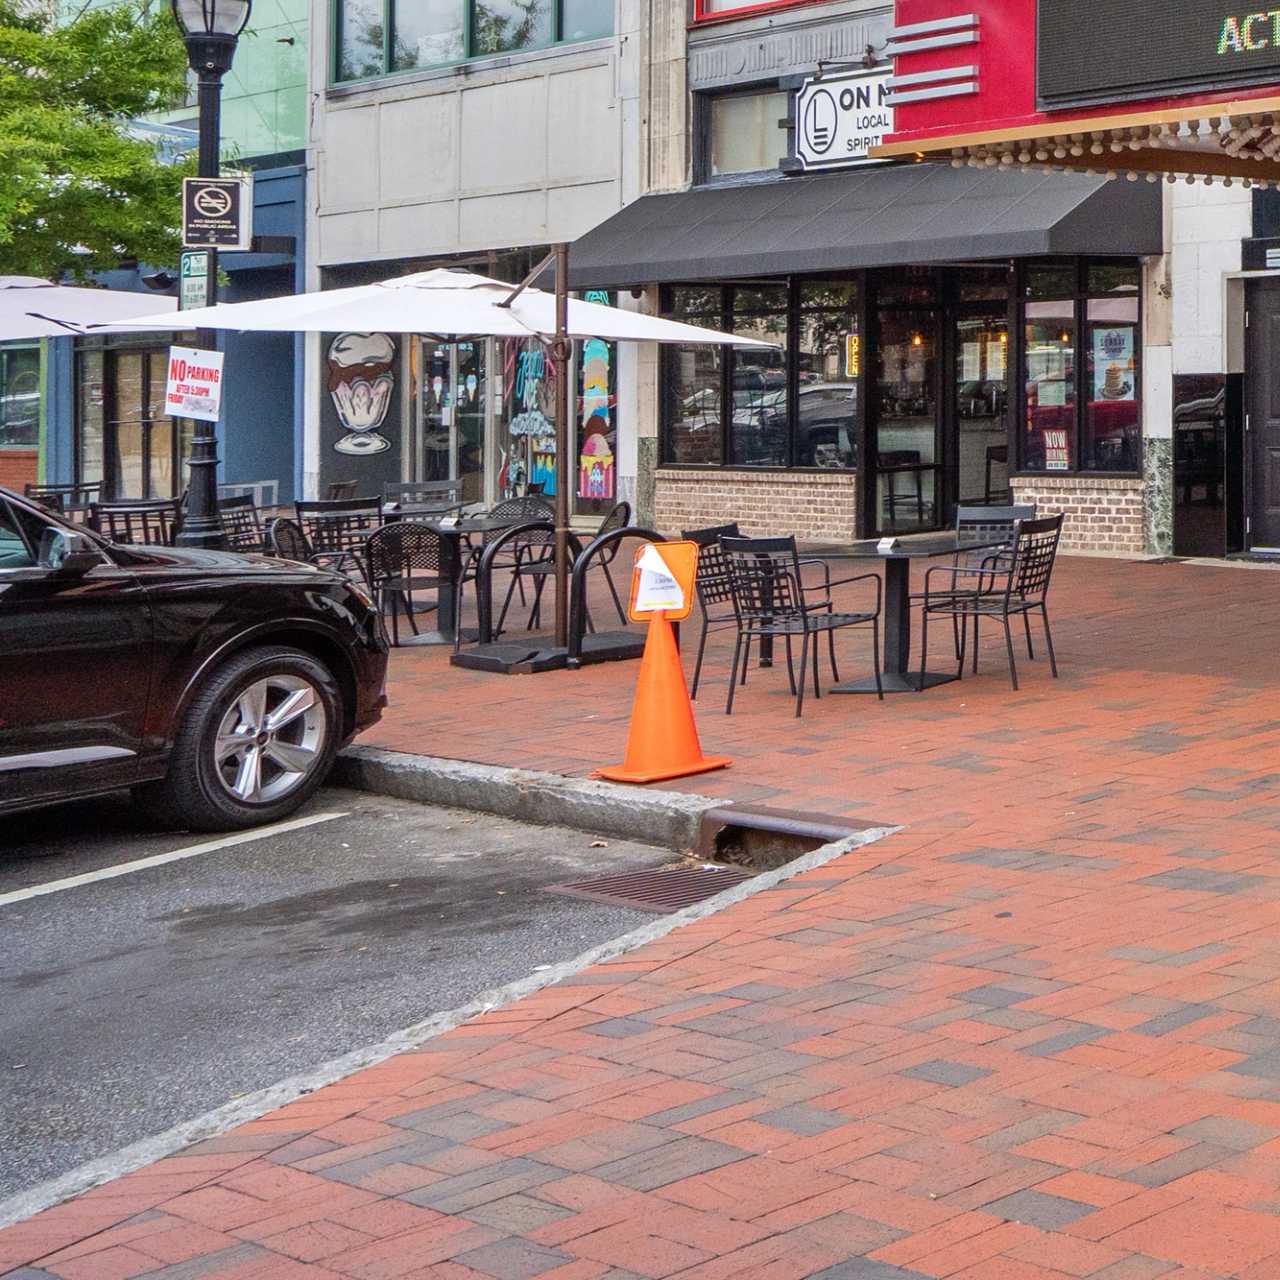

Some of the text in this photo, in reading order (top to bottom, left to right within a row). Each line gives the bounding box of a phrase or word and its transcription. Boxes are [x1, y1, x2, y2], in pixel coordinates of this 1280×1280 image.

[839, 84, 871, 112] ON
[856, 113, 889, 130] LOCAL
[851, 335, 859, 376] OPEN
[170, 358, 219, 384] NO PARKING
[1044, 431, 1066, 448] NOW
